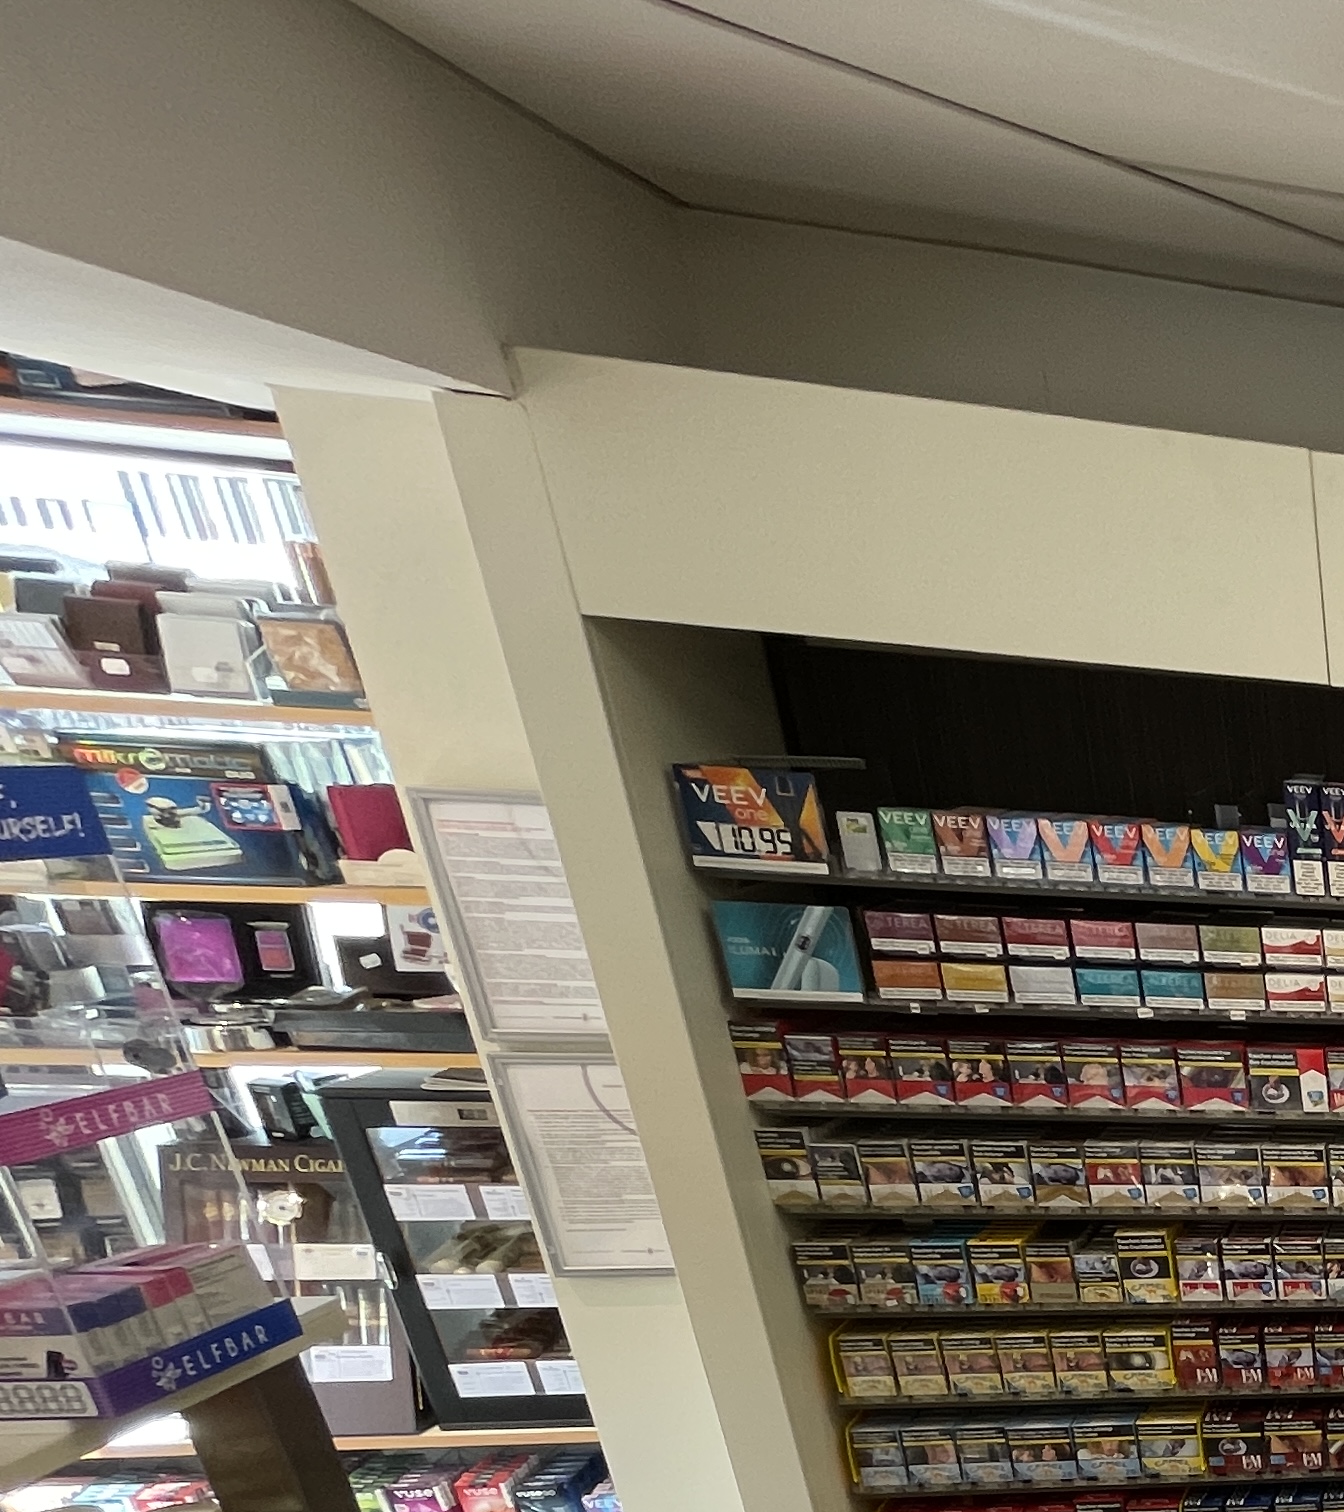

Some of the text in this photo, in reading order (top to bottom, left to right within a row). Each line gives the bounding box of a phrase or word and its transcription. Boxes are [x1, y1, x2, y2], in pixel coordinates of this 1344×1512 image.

[692, 782, 767, 807] VEEV
[1286, 784, 1314, 796] VEEV
[735, 807, 770, 823] one
[878, 809, 929, 825] VEEV
[933, 813, 984, 829] VEEV
[1242, 834, 1286, 850] VEEV
[885, 914, 935, 929] TEREA
[79, 1093, 175, 1137] ELFBAR
[209, 1153, 290, 1172] NWMAN
[182, 1324, 271, 1378] ELFBAR
